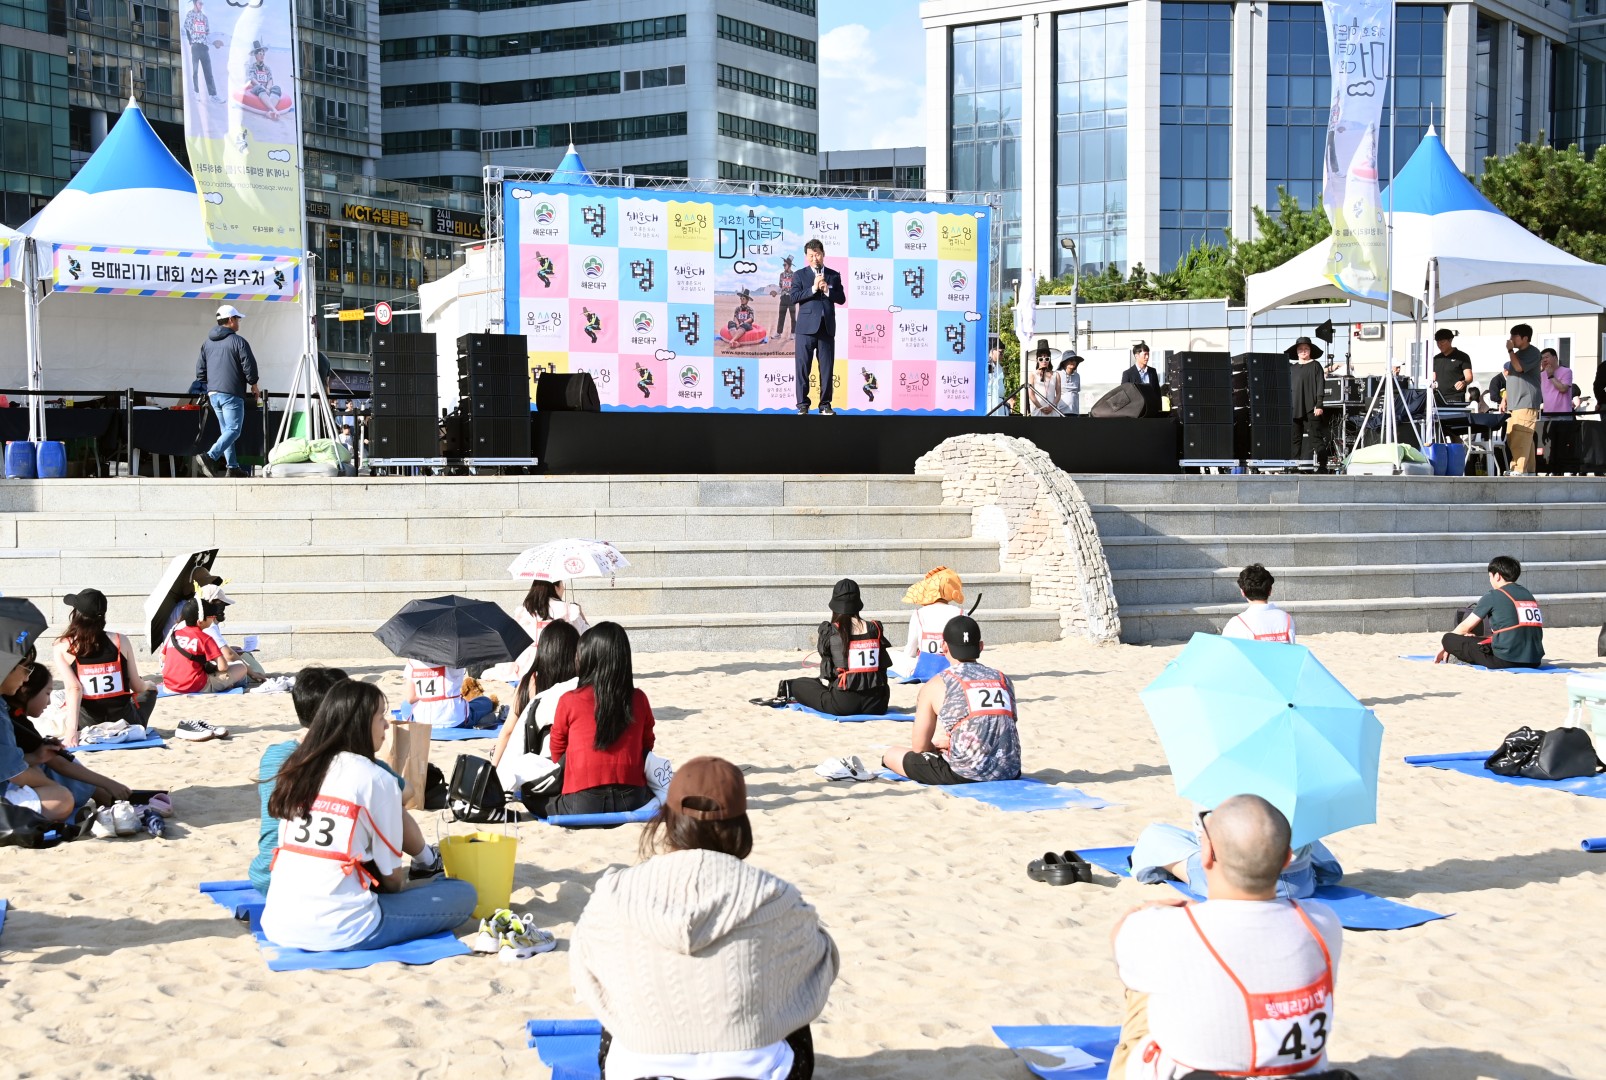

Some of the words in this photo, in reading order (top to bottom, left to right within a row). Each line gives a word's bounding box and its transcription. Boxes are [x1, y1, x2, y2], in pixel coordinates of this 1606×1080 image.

[345, 203, 373, 221] MCT
[372, 207, 408, 227] 슈팅클럽
[437, 209, 451, 219] 24시
[718, 216, 745, 227] 제2회
[532, 228, 559, 236] 해운대구
[747, 230, 784, 241] 때리기
[748, 244, 773, 255] 대회
[904, 242, 928, 251] 해운대구
[91, 261, 151, 280] 멍때리기
[156, 265, 184, 283] 대회
[190, 268, 218, 284] 선수
[223, 269, 265, 286] 접수처
[580, 281, 607, 290] 해운대구
[947, 293, 970, 302] 해운대구
[379, 309, 388, 318] 50
[631, 336, 657, 345] 해운대구
[677, 391, 703, 400] 해운대구
[1525, 608, 1541, 621] 06
[858, 650, 876, 666] 15
[89, 675, 115, 693] 13
[416, 679, 437, 696] 14
[978, 689, 1006, 708] 24
[294, 811, 336, 847] 33
[1265, 994, 1314, 1017] 멍때리기
[1277, 1011, 1327, 1060] 43
